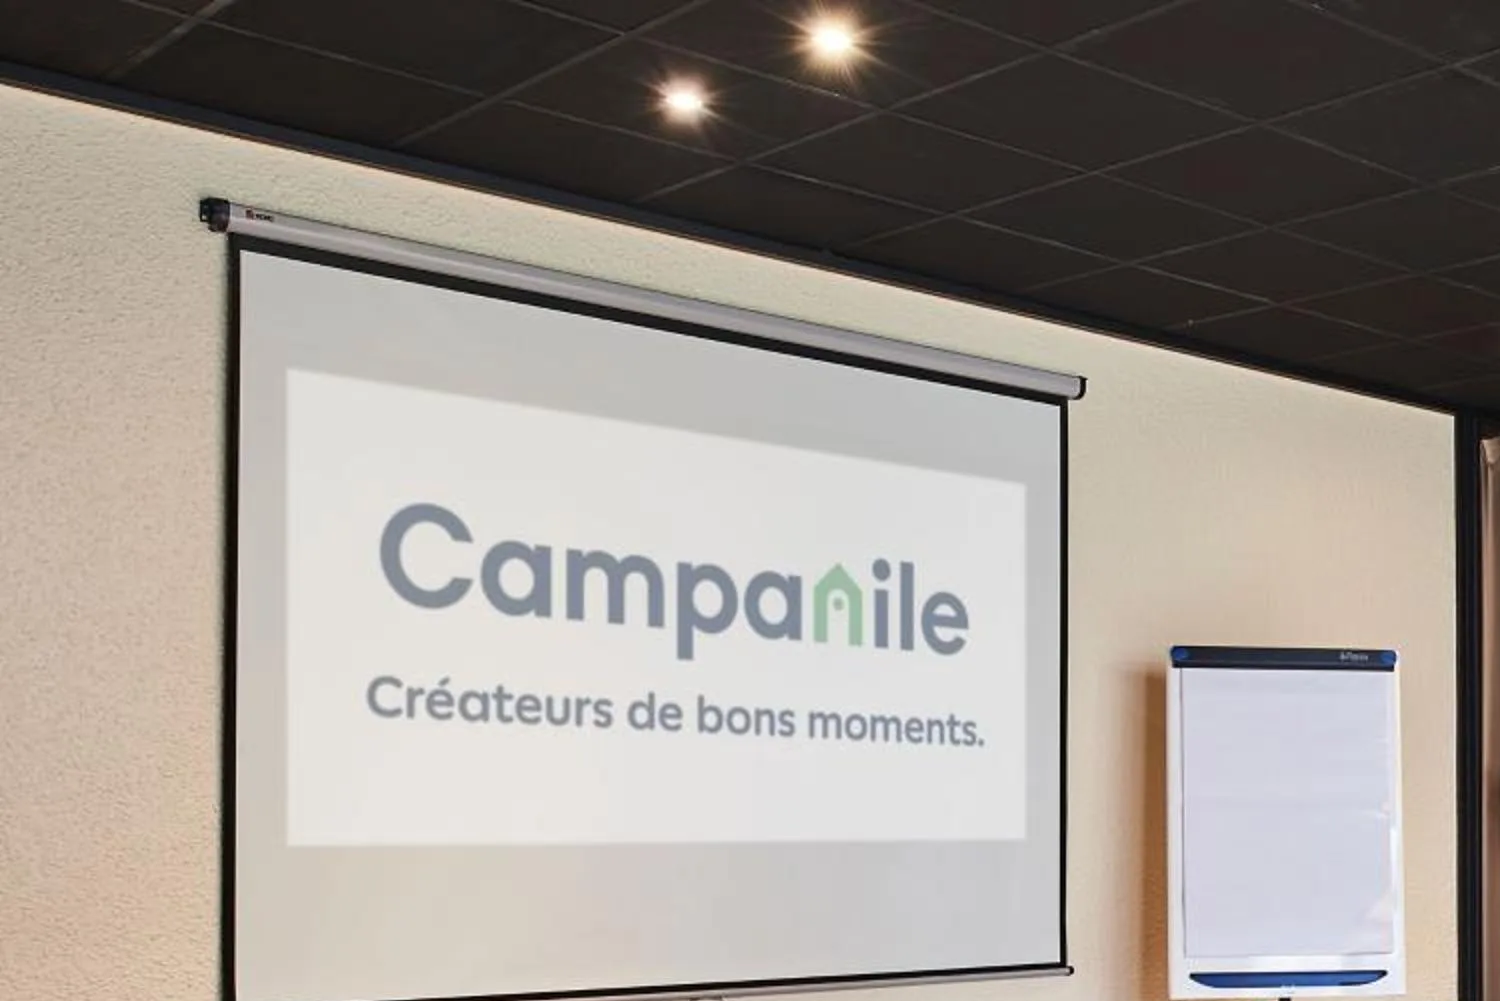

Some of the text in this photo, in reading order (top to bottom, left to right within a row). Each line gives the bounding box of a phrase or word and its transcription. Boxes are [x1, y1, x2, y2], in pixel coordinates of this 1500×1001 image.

[379, 502, 970, 661] Campanile
[366, 675, 985, 747] Créateurs de bons moments.
